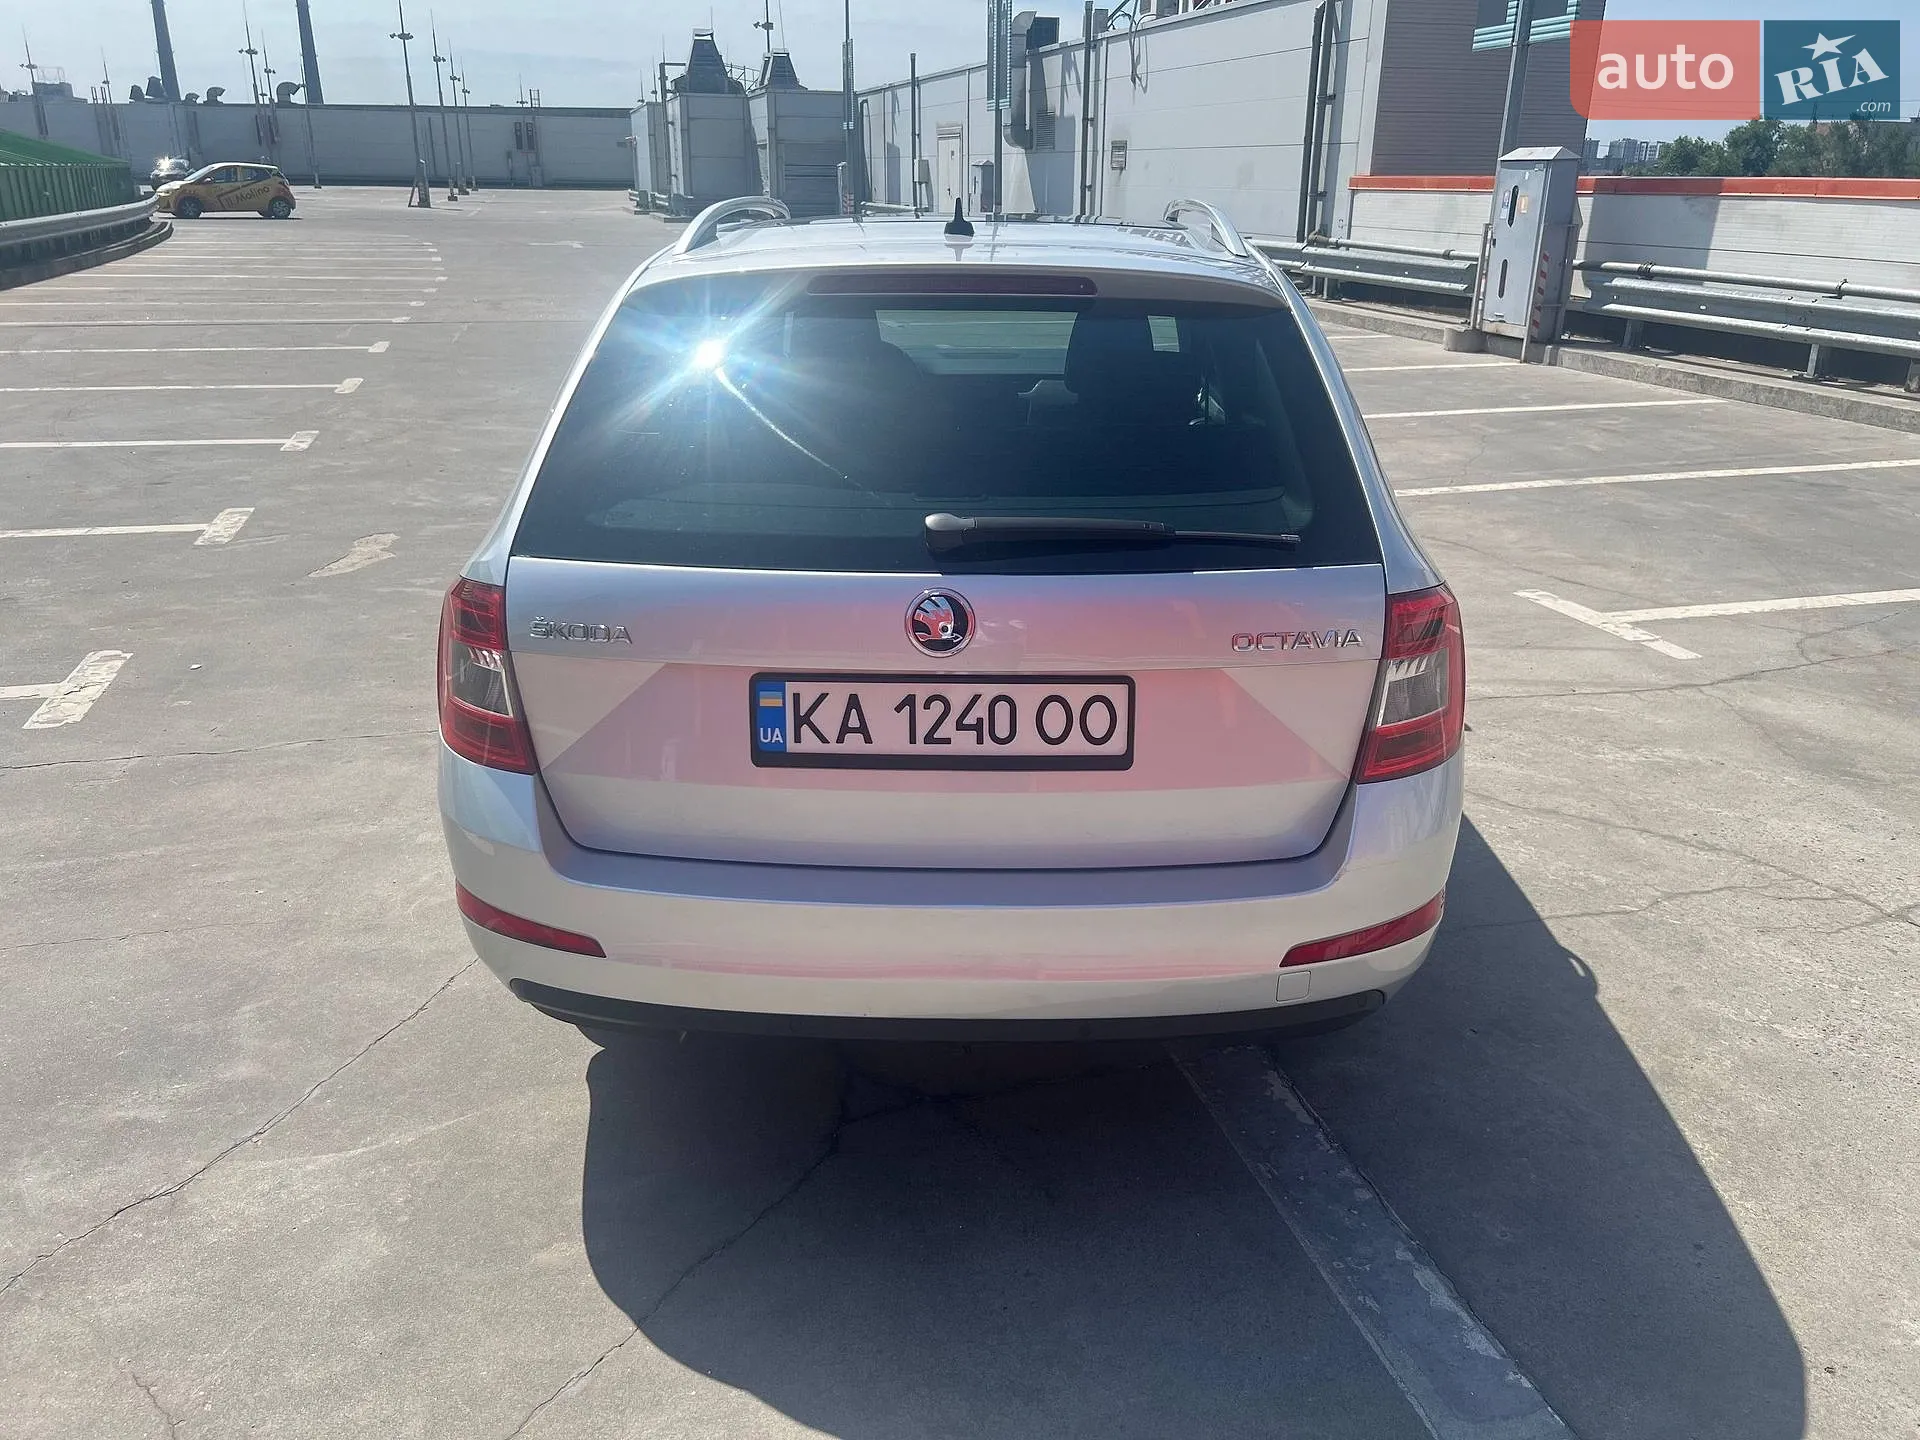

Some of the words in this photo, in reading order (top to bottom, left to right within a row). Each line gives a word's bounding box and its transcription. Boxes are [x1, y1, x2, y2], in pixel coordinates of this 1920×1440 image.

[236, 185, 271, 203] Molino
[1231, 629, 1365, 652] OCTAVIA
[792, 692, 873, 745] KA
[894, 693, 1017, 746] 1240
[1035, 694, 1118, 746] OO
[760, 727, 784, 744] UA
